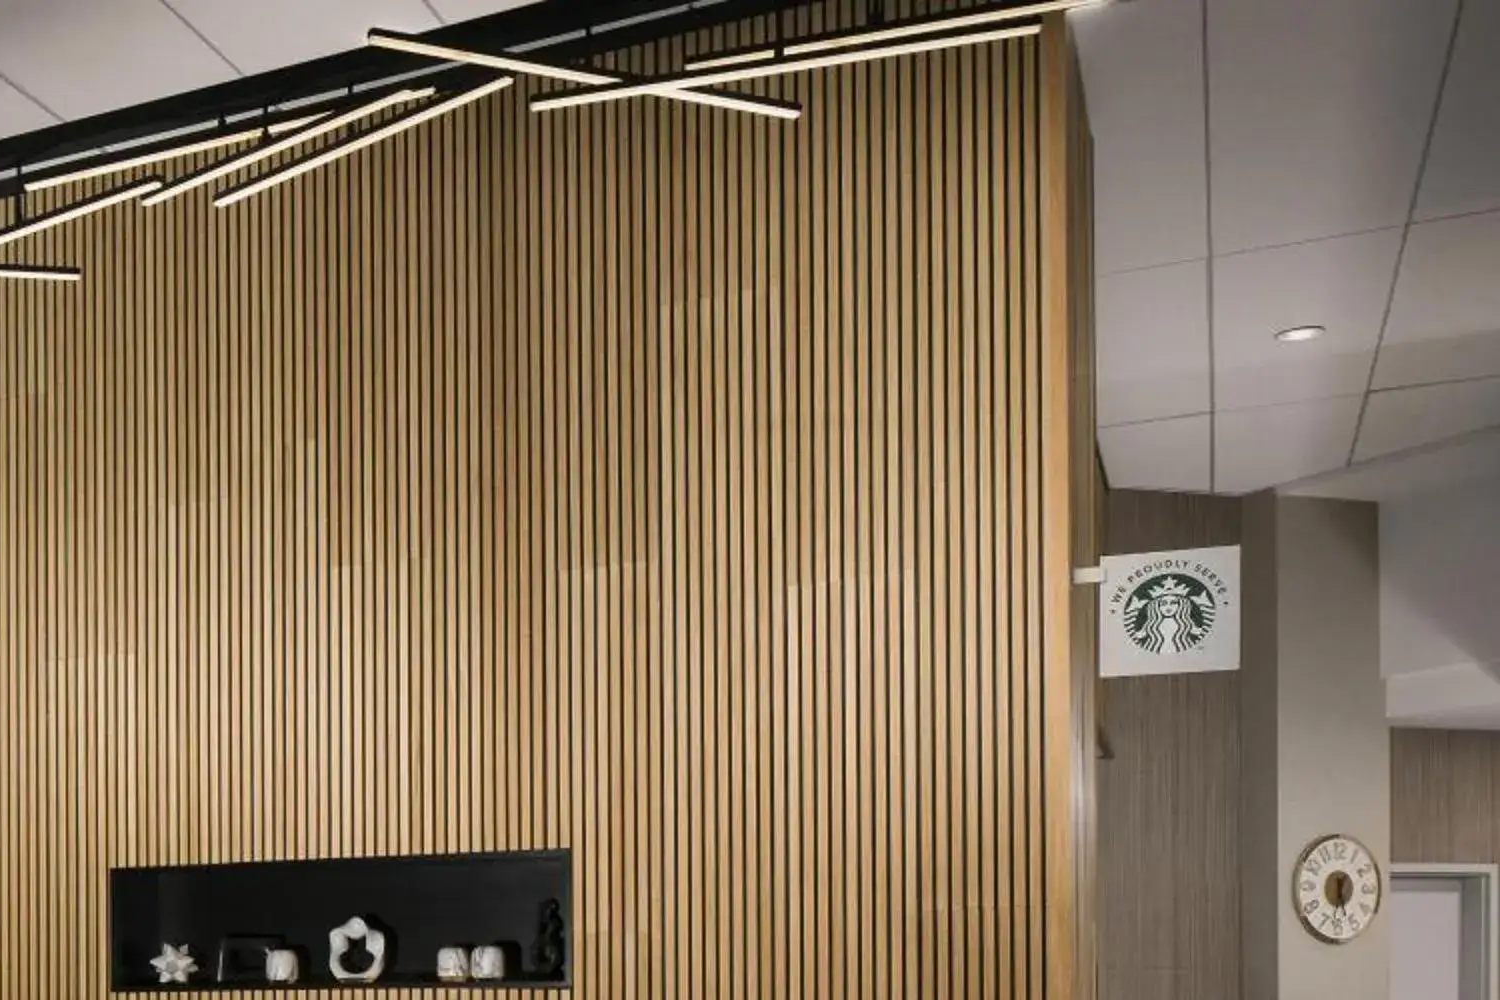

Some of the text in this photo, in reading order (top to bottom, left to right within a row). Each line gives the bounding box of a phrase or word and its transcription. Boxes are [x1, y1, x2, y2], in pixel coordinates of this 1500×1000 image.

[1111, 559, 1228, 605] WE PROUDLY SERVE
[1332, 841, 1348, 860] 12
[1318, 913, 1331, 930] 7
